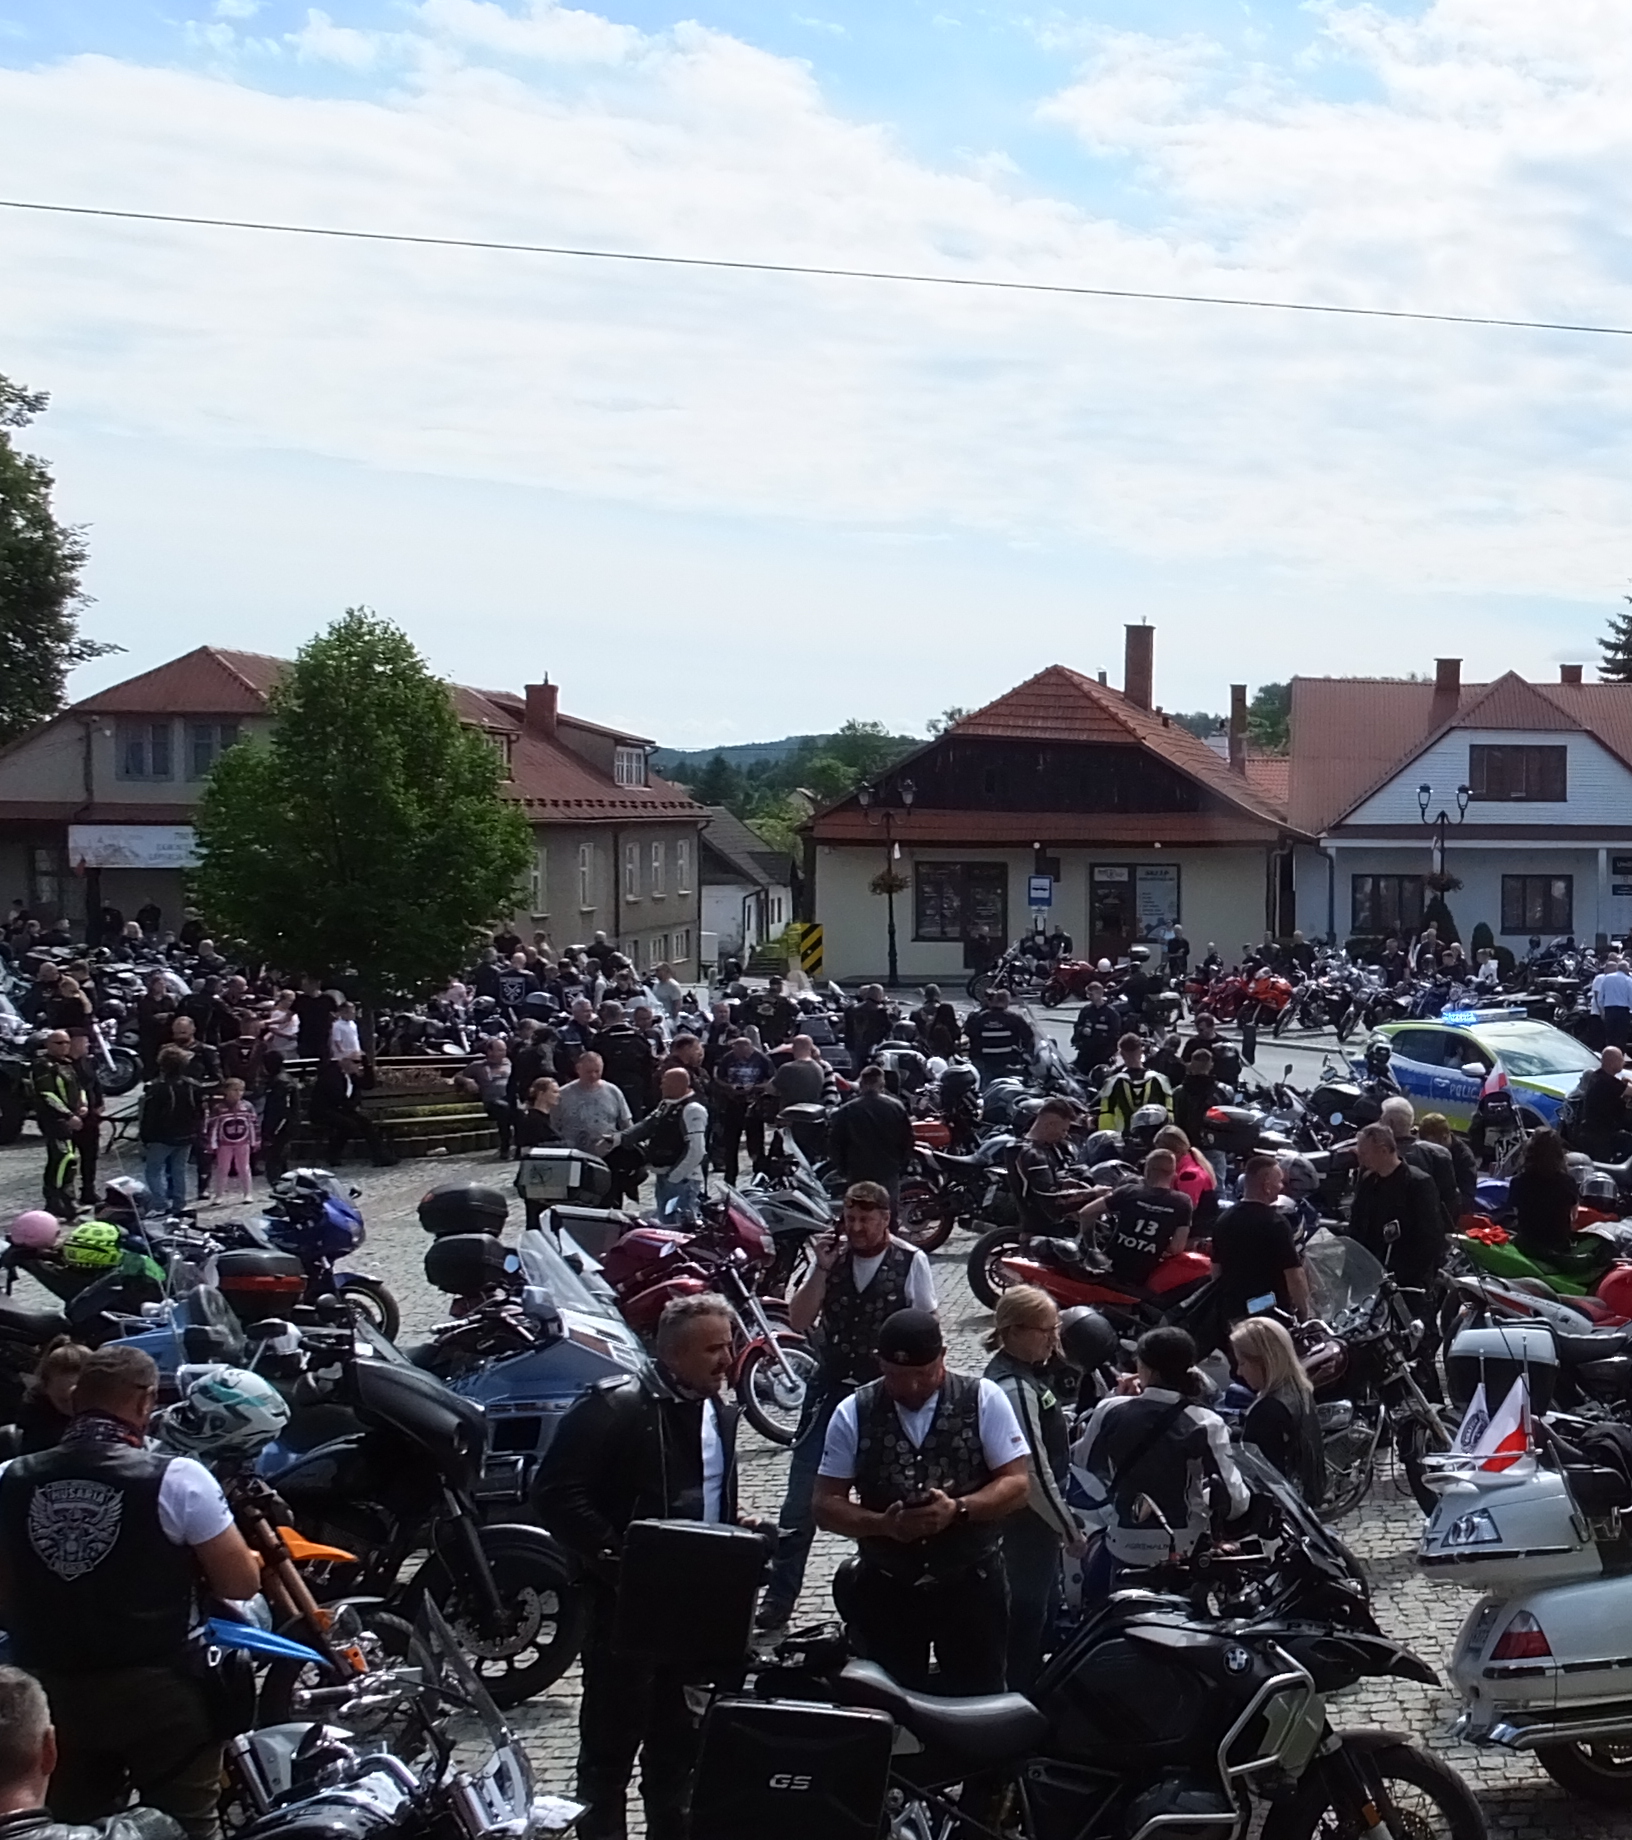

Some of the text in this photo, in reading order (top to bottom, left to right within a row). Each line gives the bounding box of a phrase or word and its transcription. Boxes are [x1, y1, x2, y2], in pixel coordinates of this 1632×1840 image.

[1450, 1083, 1479, 1099] POLIC
[1134, 1219, 1159, 1236] 13
[769, 1773, 813, 1790] GS
